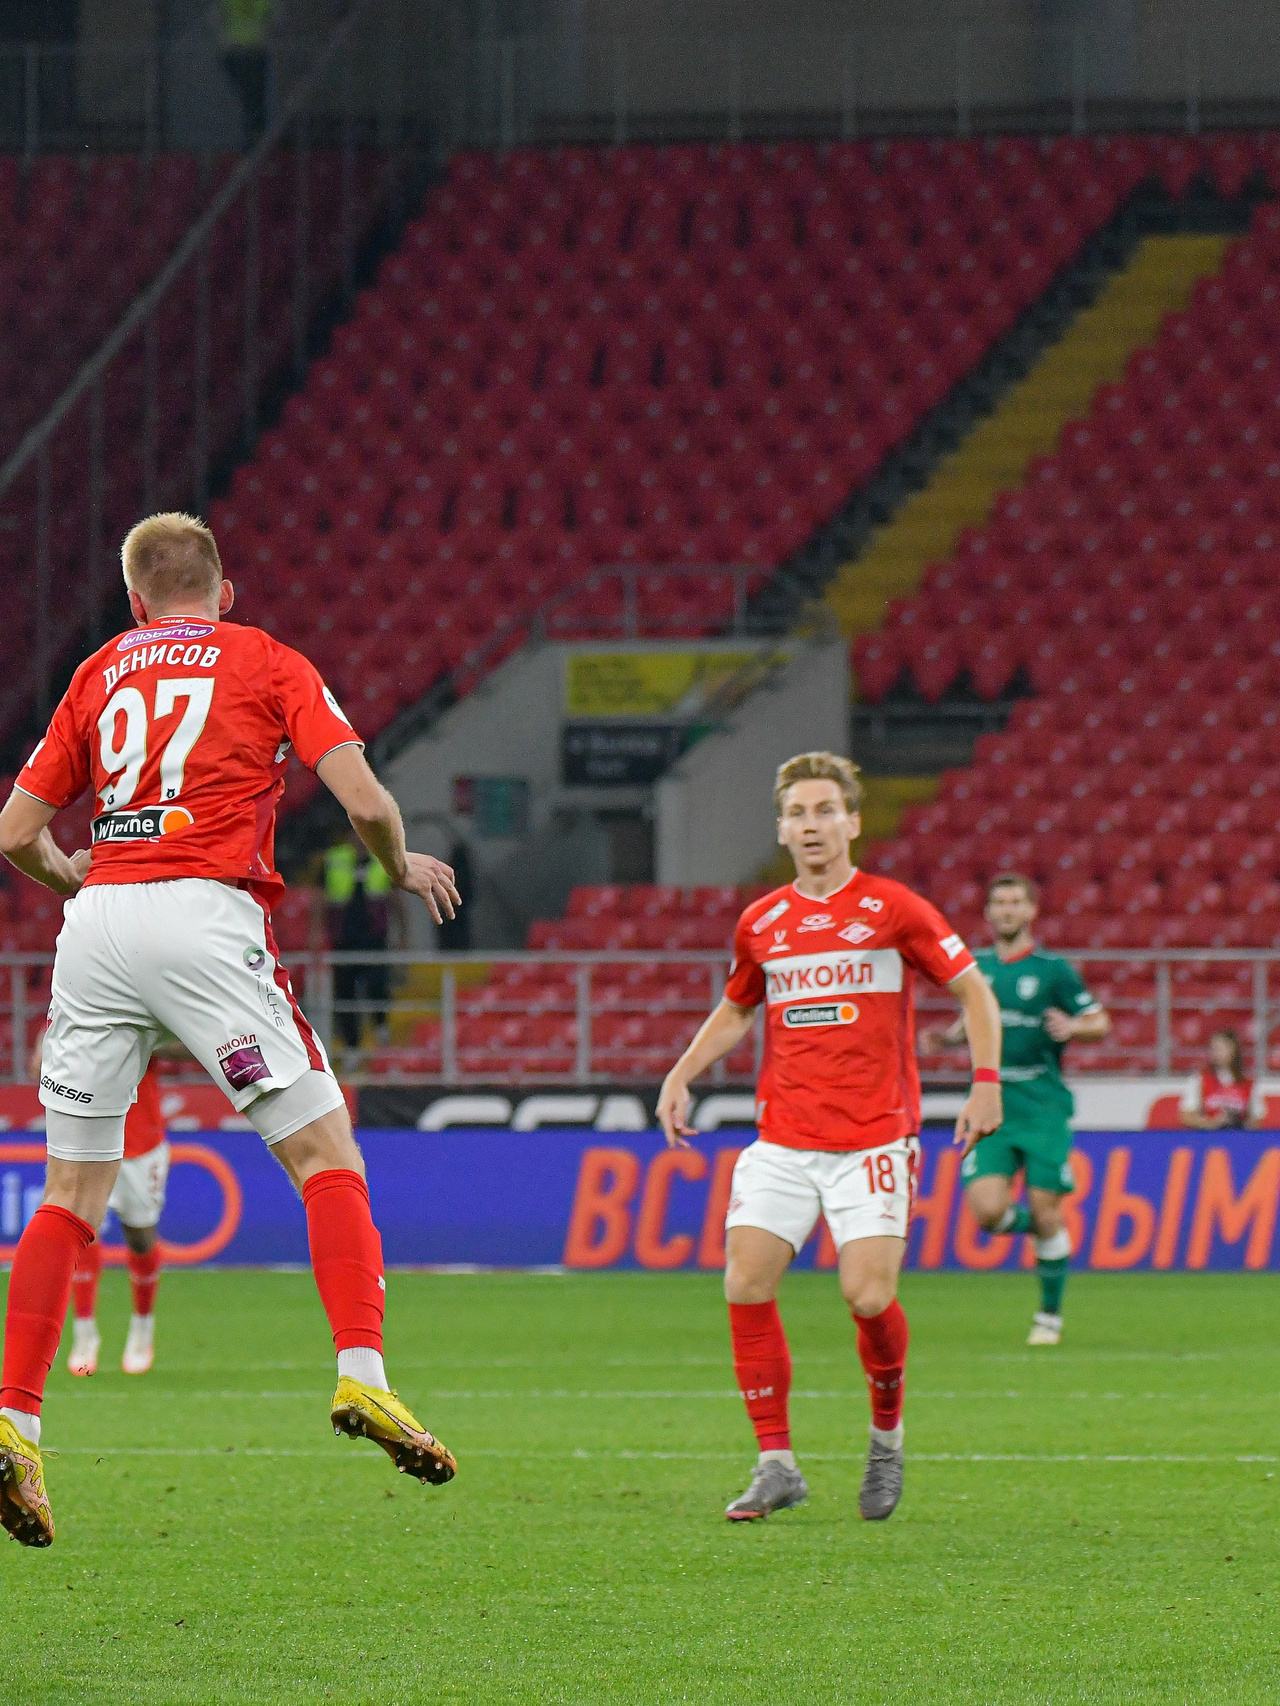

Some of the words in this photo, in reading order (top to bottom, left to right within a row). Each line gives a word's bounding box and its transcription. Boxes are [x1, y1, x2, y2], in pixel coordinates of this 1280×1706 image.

[123, 626, 208, 646] wildberries
[102, 643, 222, 695] ДЕНИСОВ
[97, 676, 216, 813] 97
[770, 959, 873, 995] ЛУКОЙЛ
[215, 1033, 258, 1059] ЛУКОЙЛ
[40, 1075, 95, 1104] GENESIS
[862, 1153, 896, 1196] 18
